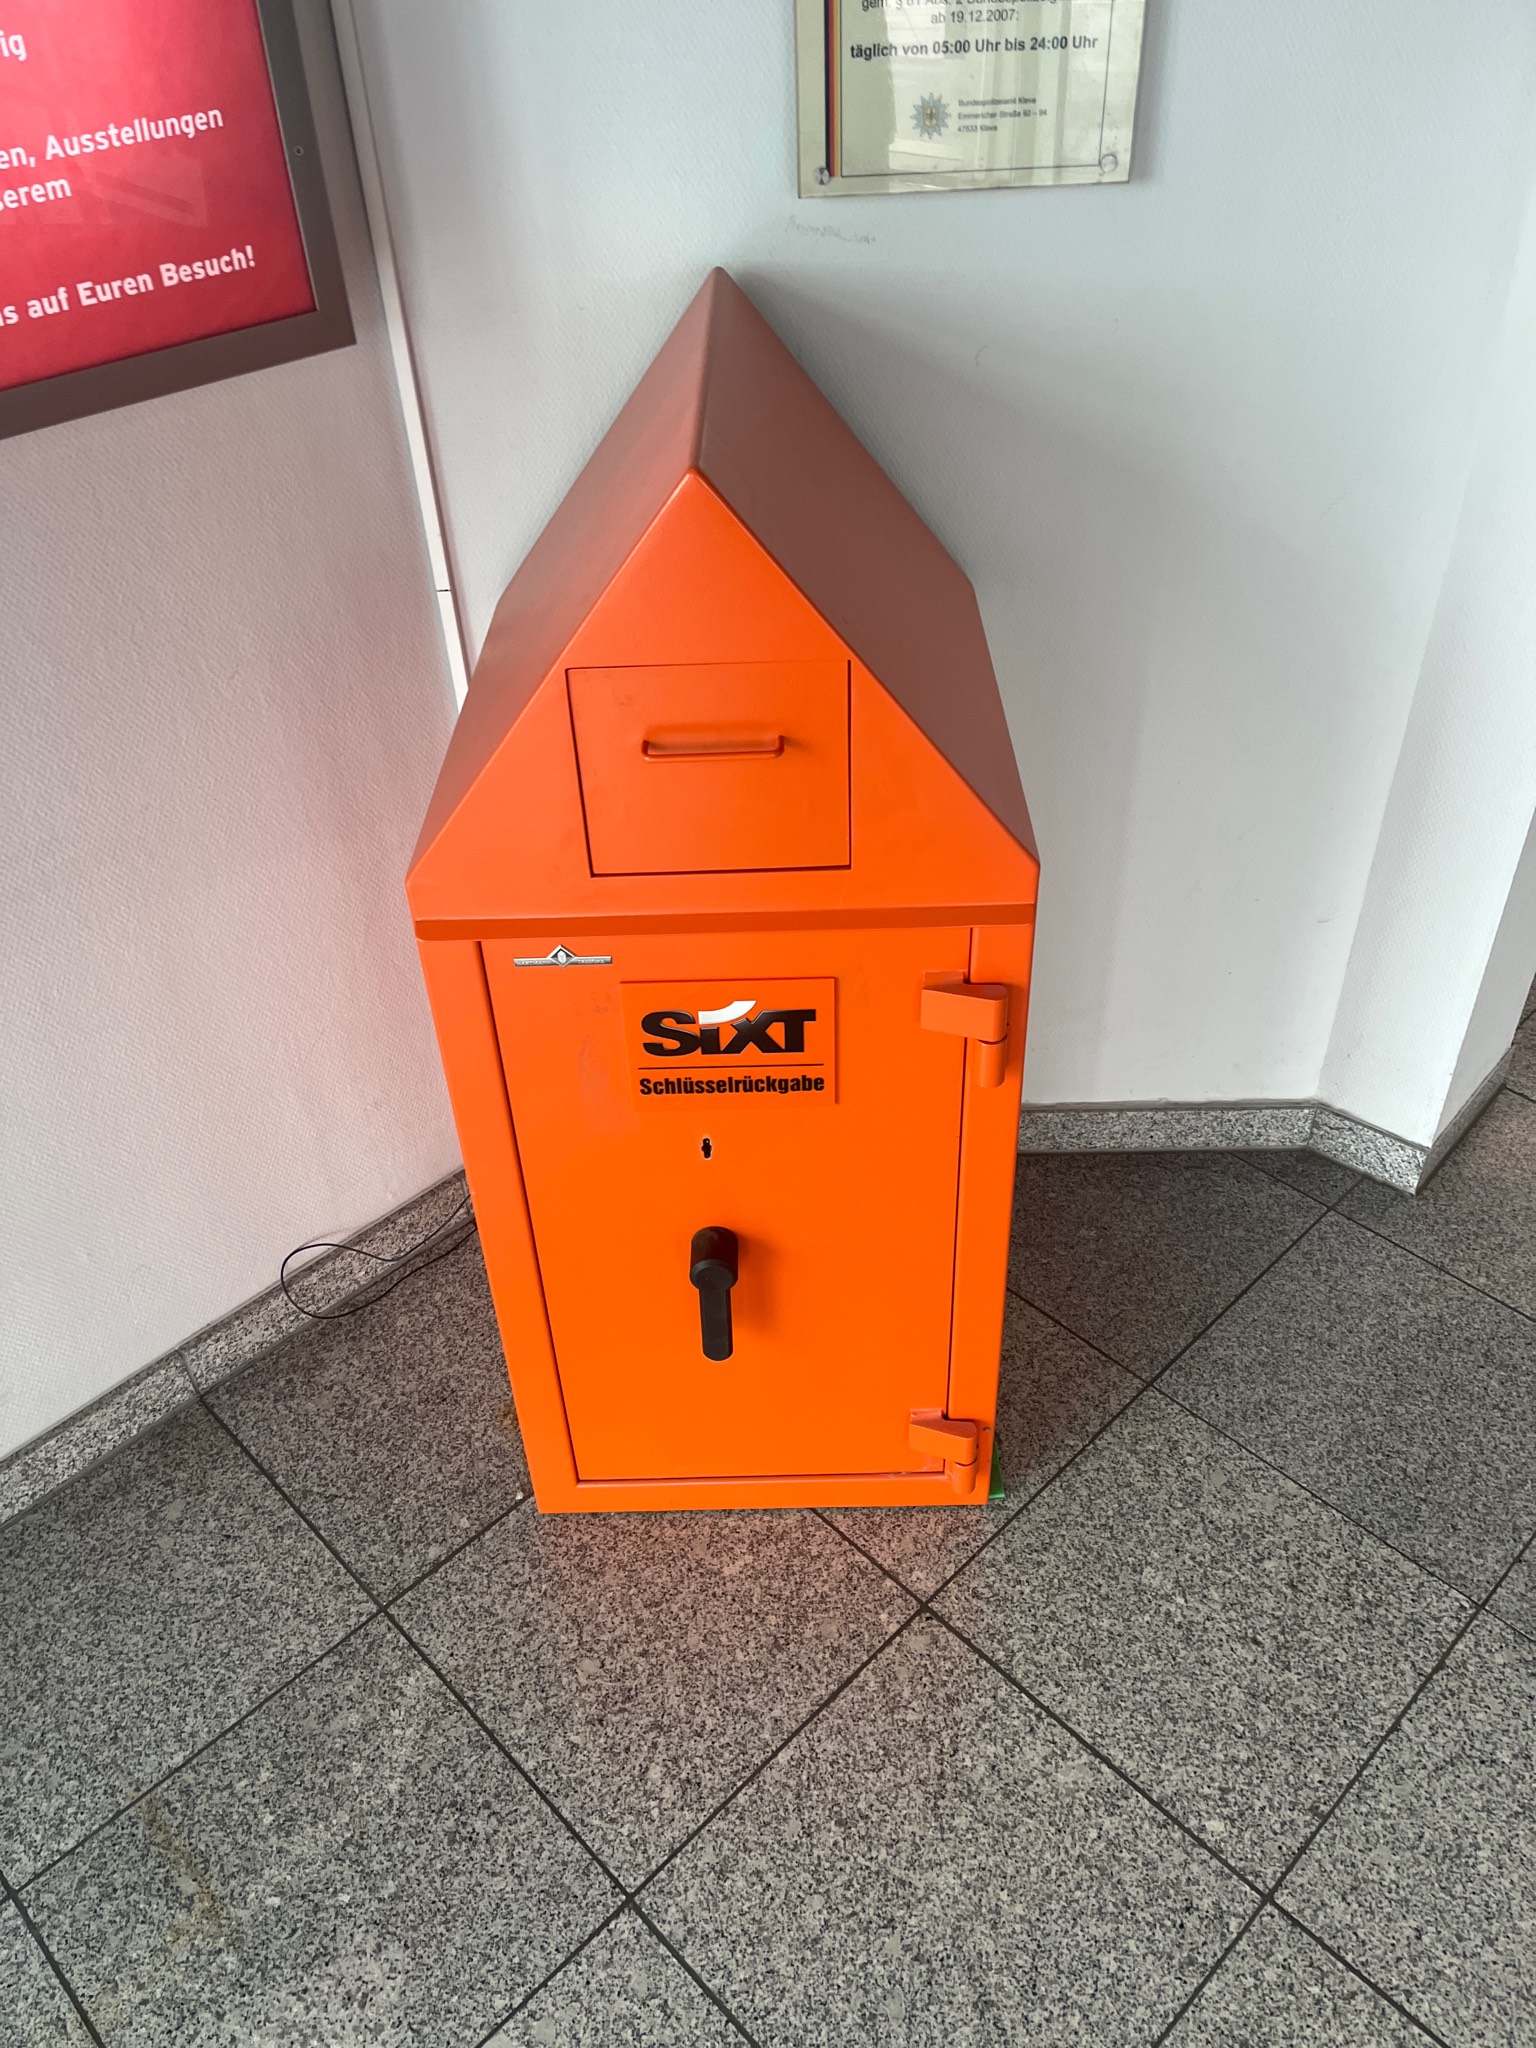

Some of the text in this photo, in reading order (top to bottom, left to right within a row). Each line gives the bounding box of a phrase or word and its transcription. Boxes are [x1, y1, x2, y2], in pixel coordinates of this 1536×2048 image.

[931, 9, 1020, 24] ab 19.12.2007:
[850, 35, 1098, 60] täglich von 05:00 Uhr bis 24:00 Uhr
[998, 110, 1021, 118] Straße
[45, 108, 224, 161] Ausstellungen
[0, 245, 256, 327] s auf Euren Besuch!
[639, 1074, 826, 1096] Schlüsselrückgabe
